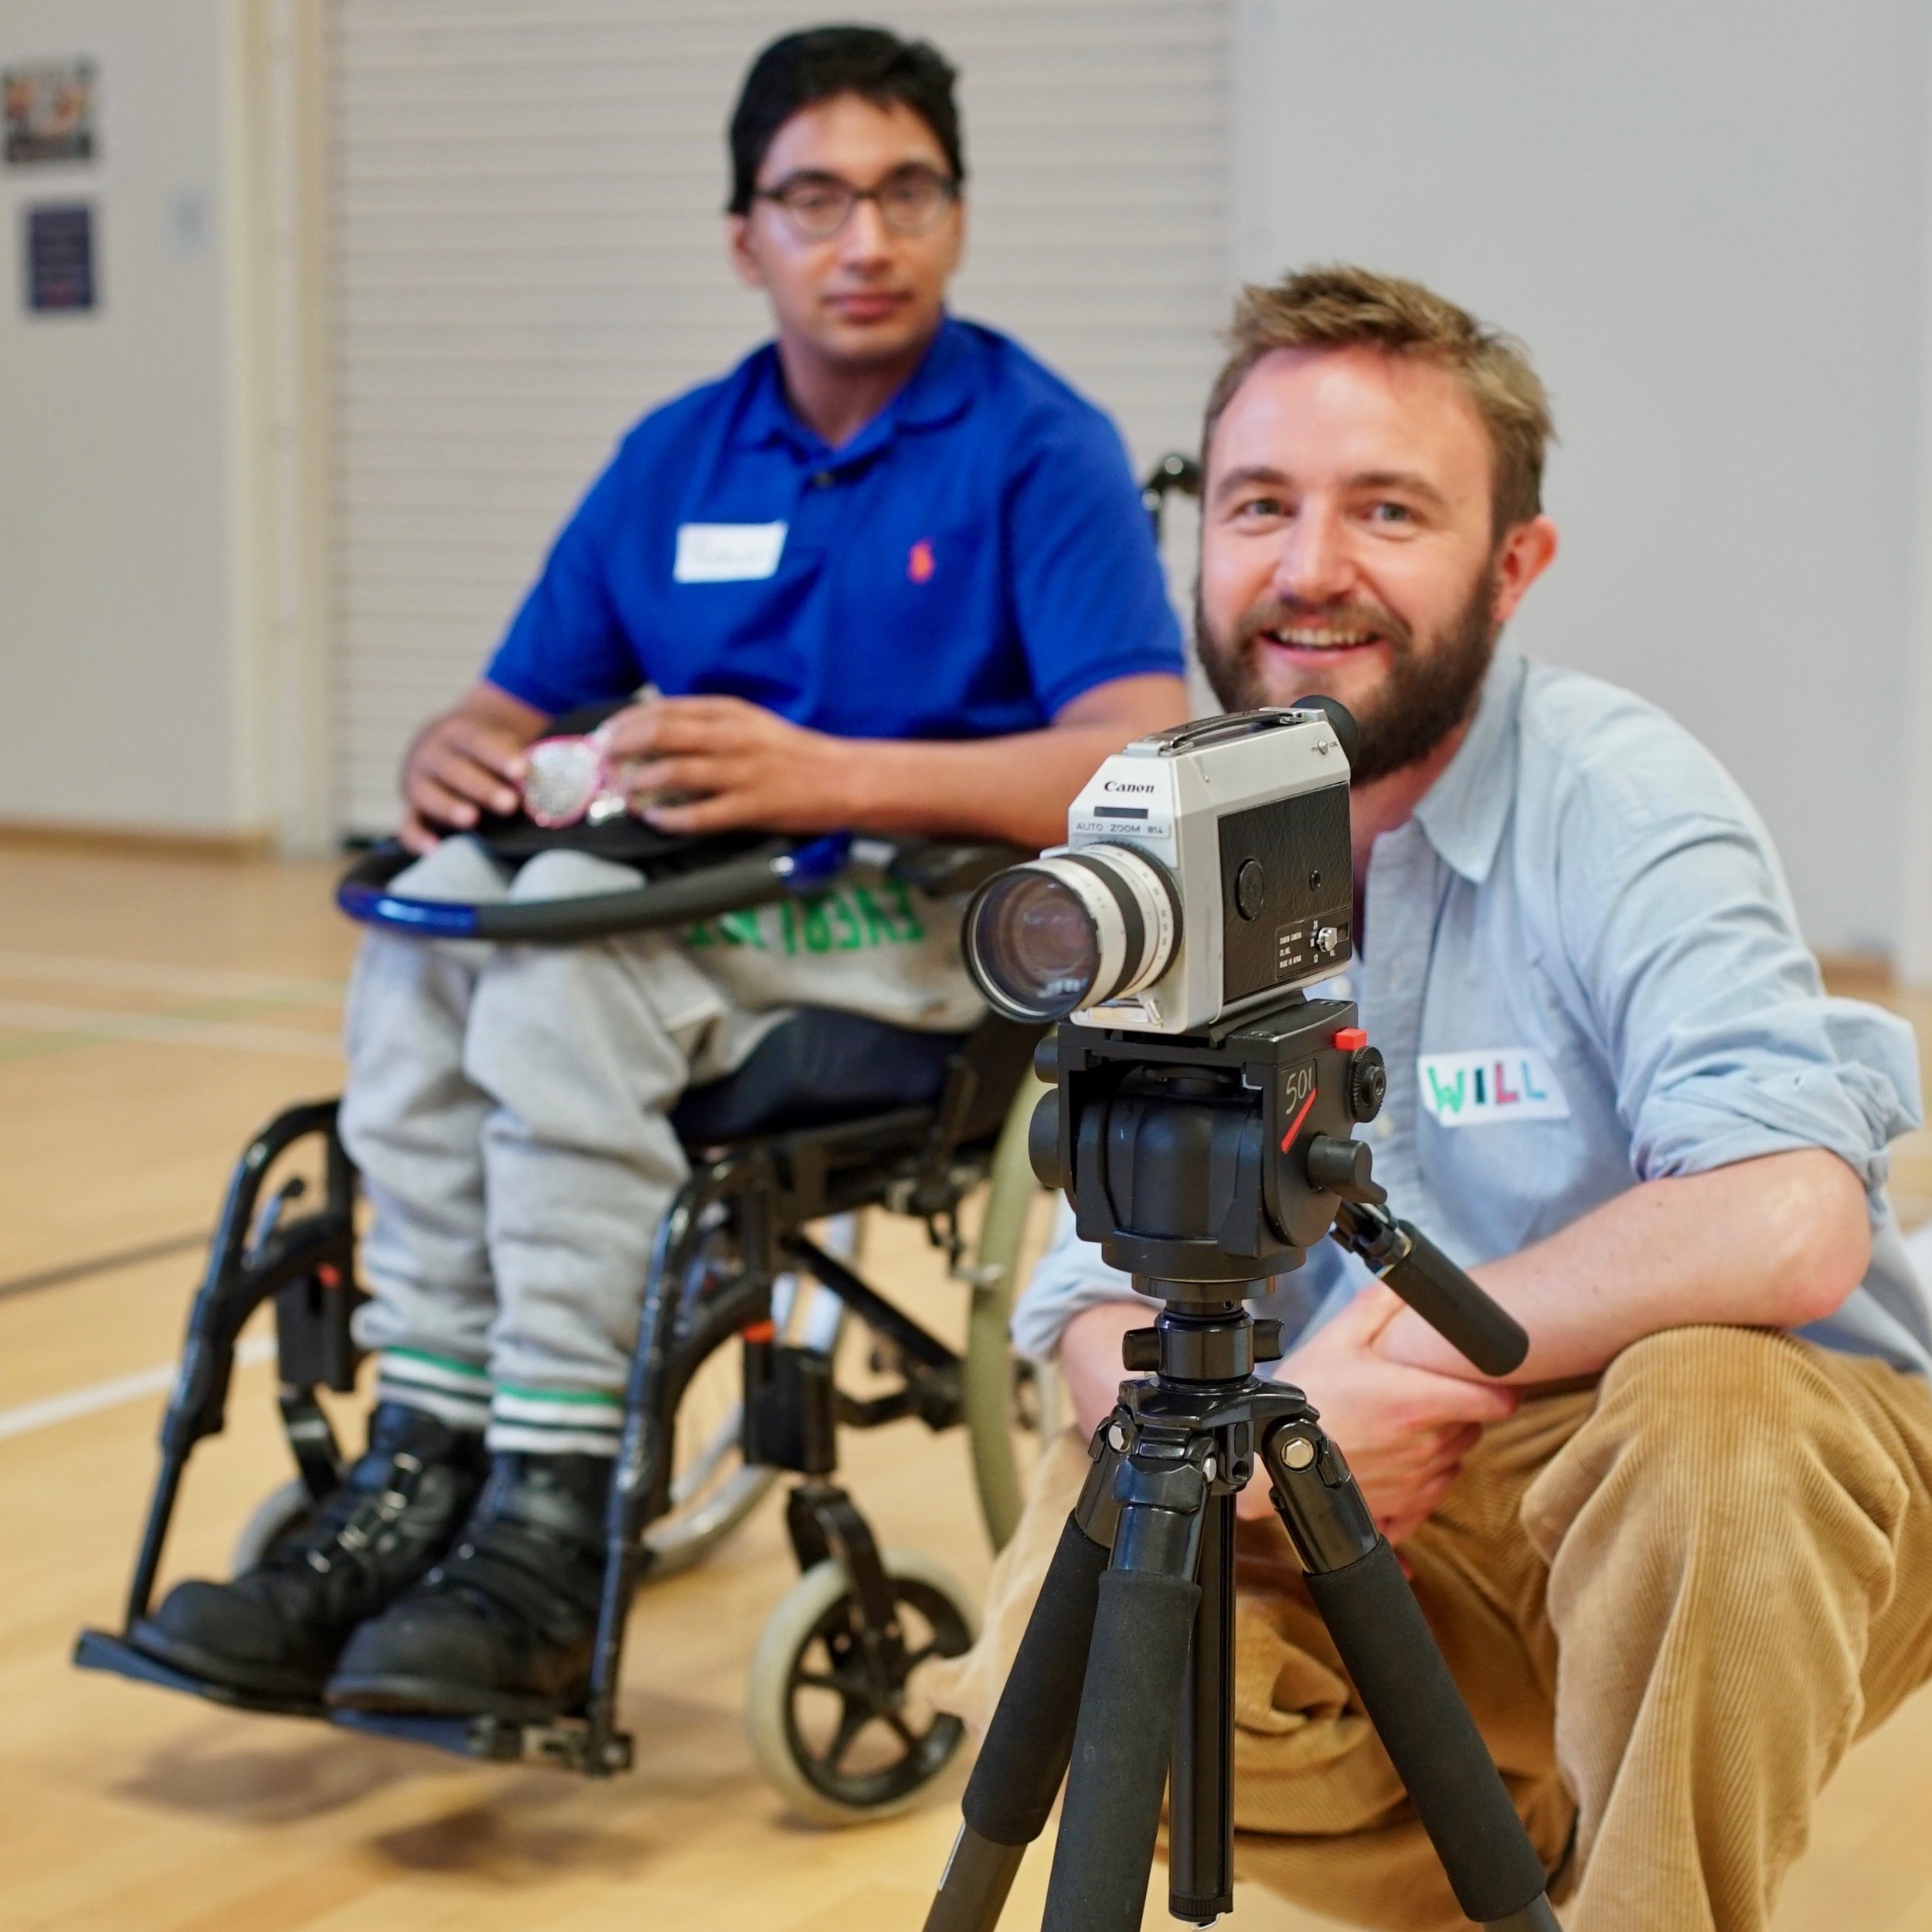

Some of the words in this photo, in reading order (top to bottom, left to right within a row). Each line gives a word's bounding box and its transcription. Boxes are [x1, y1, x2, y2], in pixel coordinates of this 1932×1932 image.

[1104, 781, 1155, 794] Canon
[1077, 822, 1104, 832] AUTO
[1110, 824, 1141, 833] ZOOM
[1286, 1067, 1312, 1115] 501
[1427, 1059, 1547, 1114] WILL
